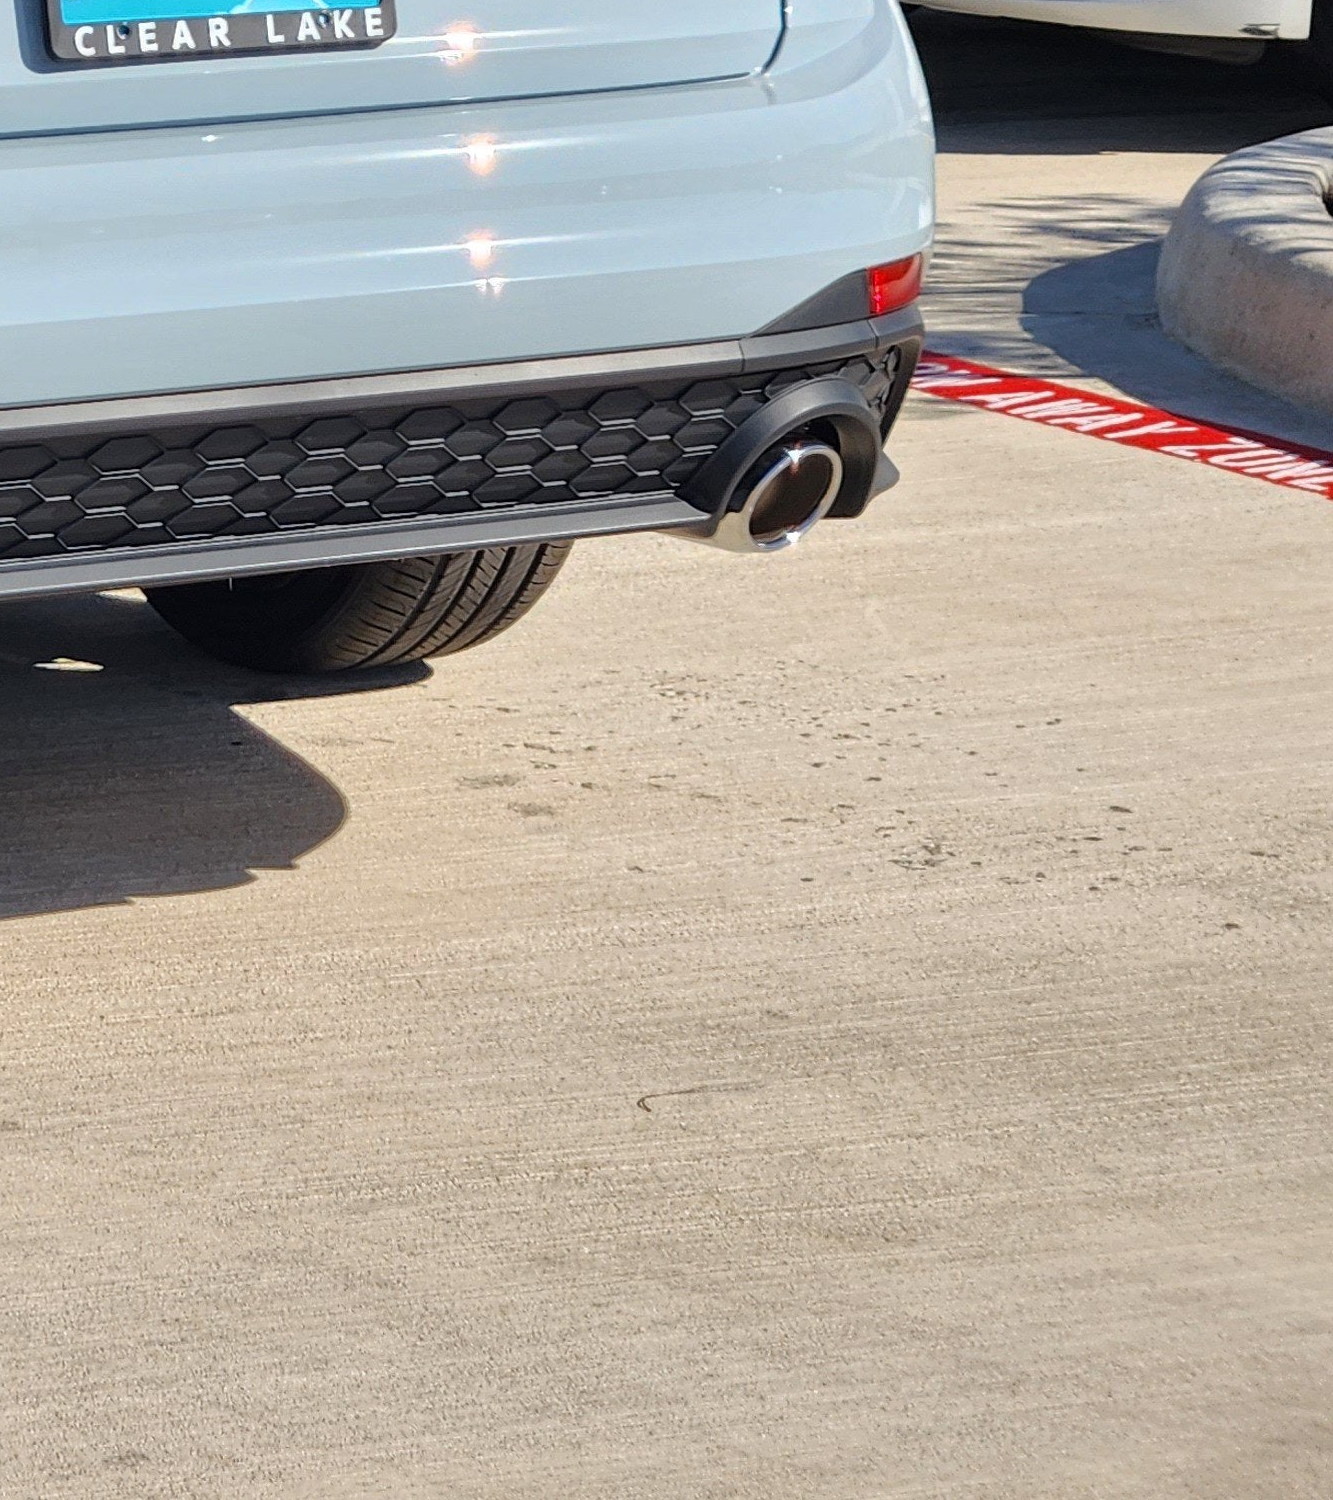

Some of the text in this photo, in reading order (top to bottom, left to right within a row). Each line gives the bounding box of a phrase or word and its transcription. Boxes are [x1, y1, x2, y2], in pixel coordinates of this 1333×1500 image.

[74, 7, 385, 57] CLEAR LAKE
[957, 390, 1200, 439] AWAY
